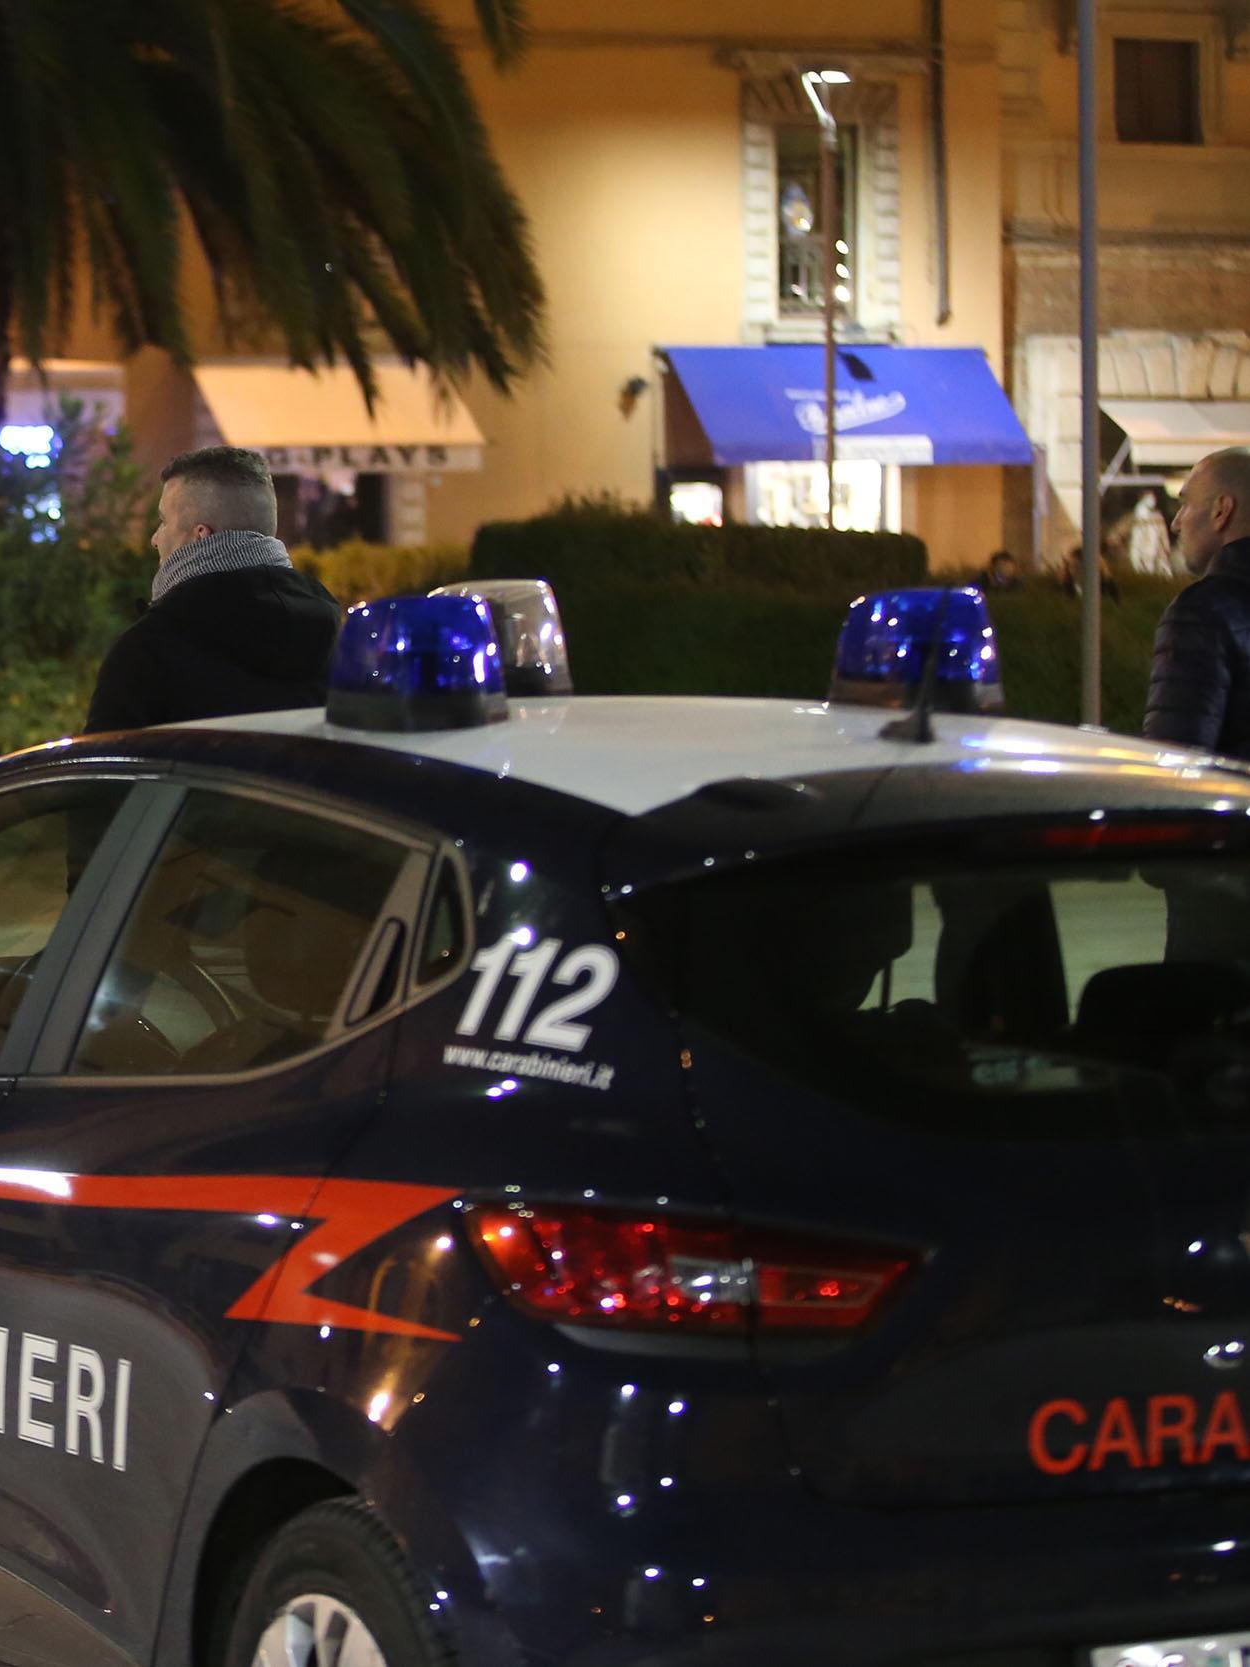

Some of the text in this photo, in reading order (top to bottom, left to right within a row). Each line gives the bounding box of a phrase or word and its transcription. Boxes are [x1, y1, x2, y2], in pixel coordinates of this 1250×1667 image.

[455, 932, 620, 1053] 112
[443, 1045, 615, 1090] www.carabinieri.it
[1028, 1391, 1250, 1475] CARA
